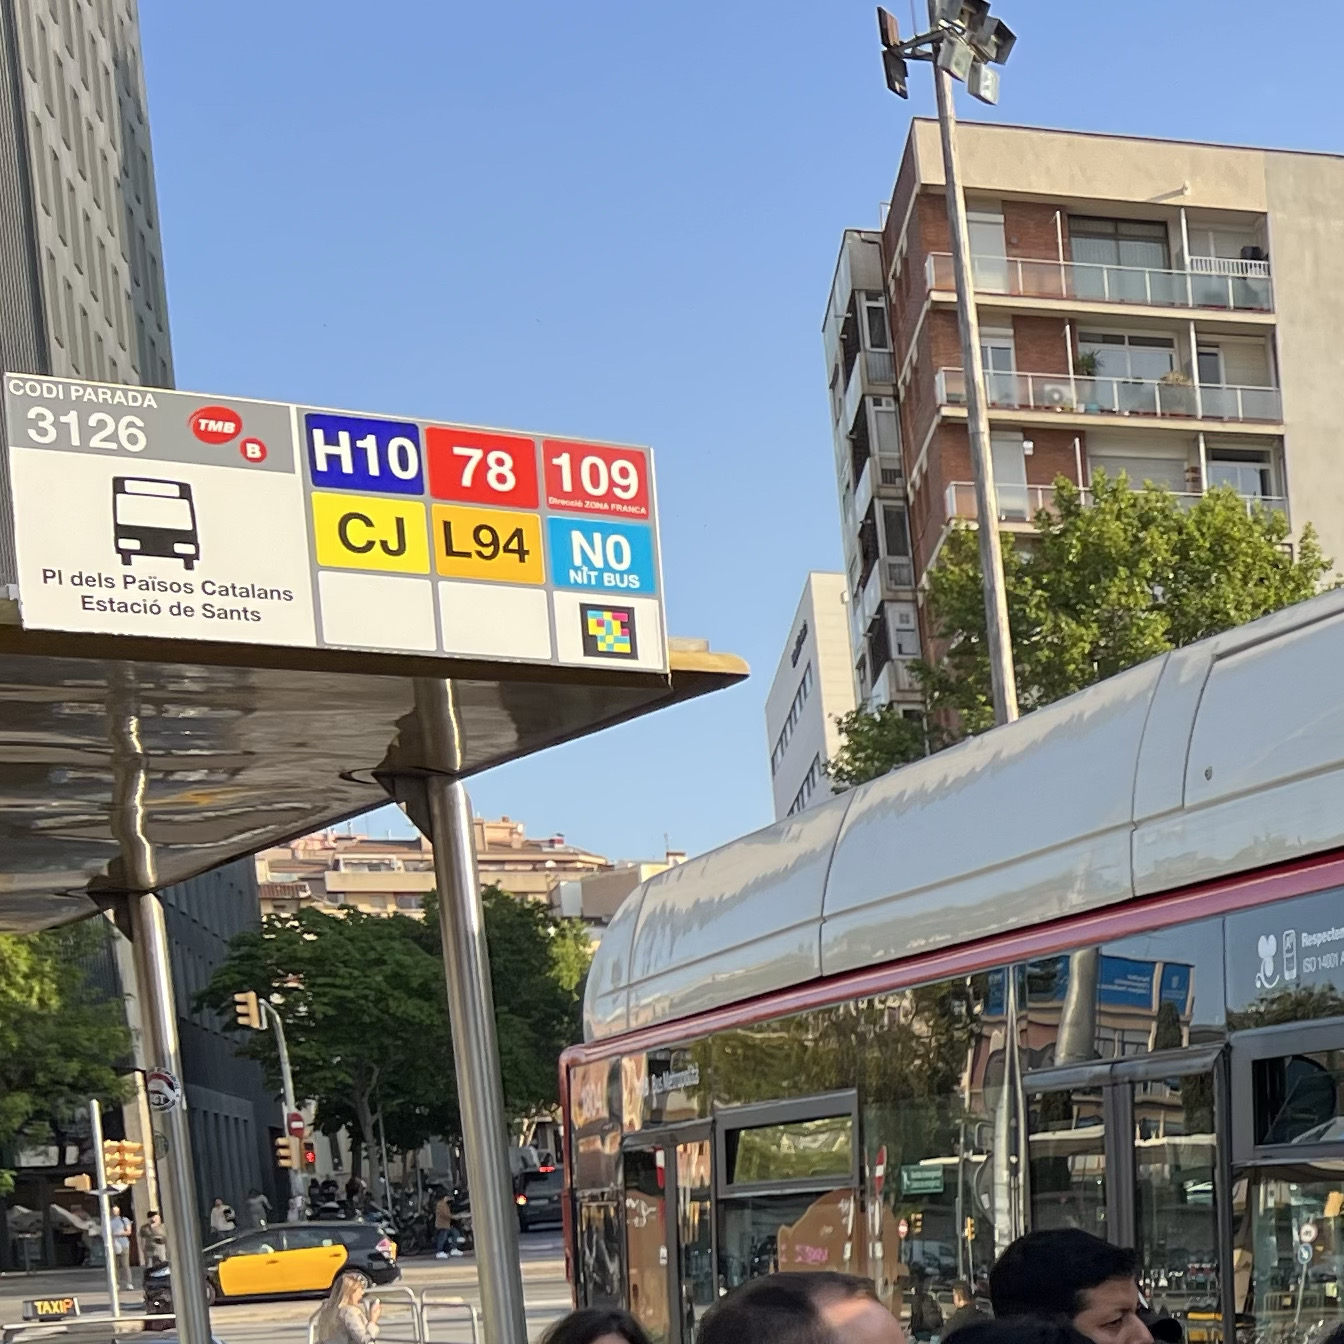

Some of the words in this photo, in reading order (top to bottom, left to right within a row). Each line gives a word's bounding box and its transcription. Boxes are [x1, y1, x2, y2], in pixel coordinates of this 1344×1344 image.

[9, 380, 64, 400] CODI
[71, 388, 158, 409] PARADA
[27, 406, 147, 453] 3126
[199, 418, 235, 434] TMB
[246, 443, 261, 458] B
[311, 428, 420, 480] H10
[453, 446, 517, 493] 78
[552, 452, 639, 500] 109
[584, 500, 609, 510] ZONA
[611, 503, 647, 514] FRANCA
[337, 512, 407, 557] CJ
[442, 520, 530, 564] L94
[70, 573, 116, 589] dels
[123, 574, 194, 594] Països
[201, 580, 294, 602] Catalans
[569, 567, 598, 585] NIT
[603, 572, 640, 588] BUS
[81, 595, 161, 616] Estació
[169, 601, 195, 618] de
[202, 603, 262, 623] Sants
[1303, 957, 1317, 973] ISO
